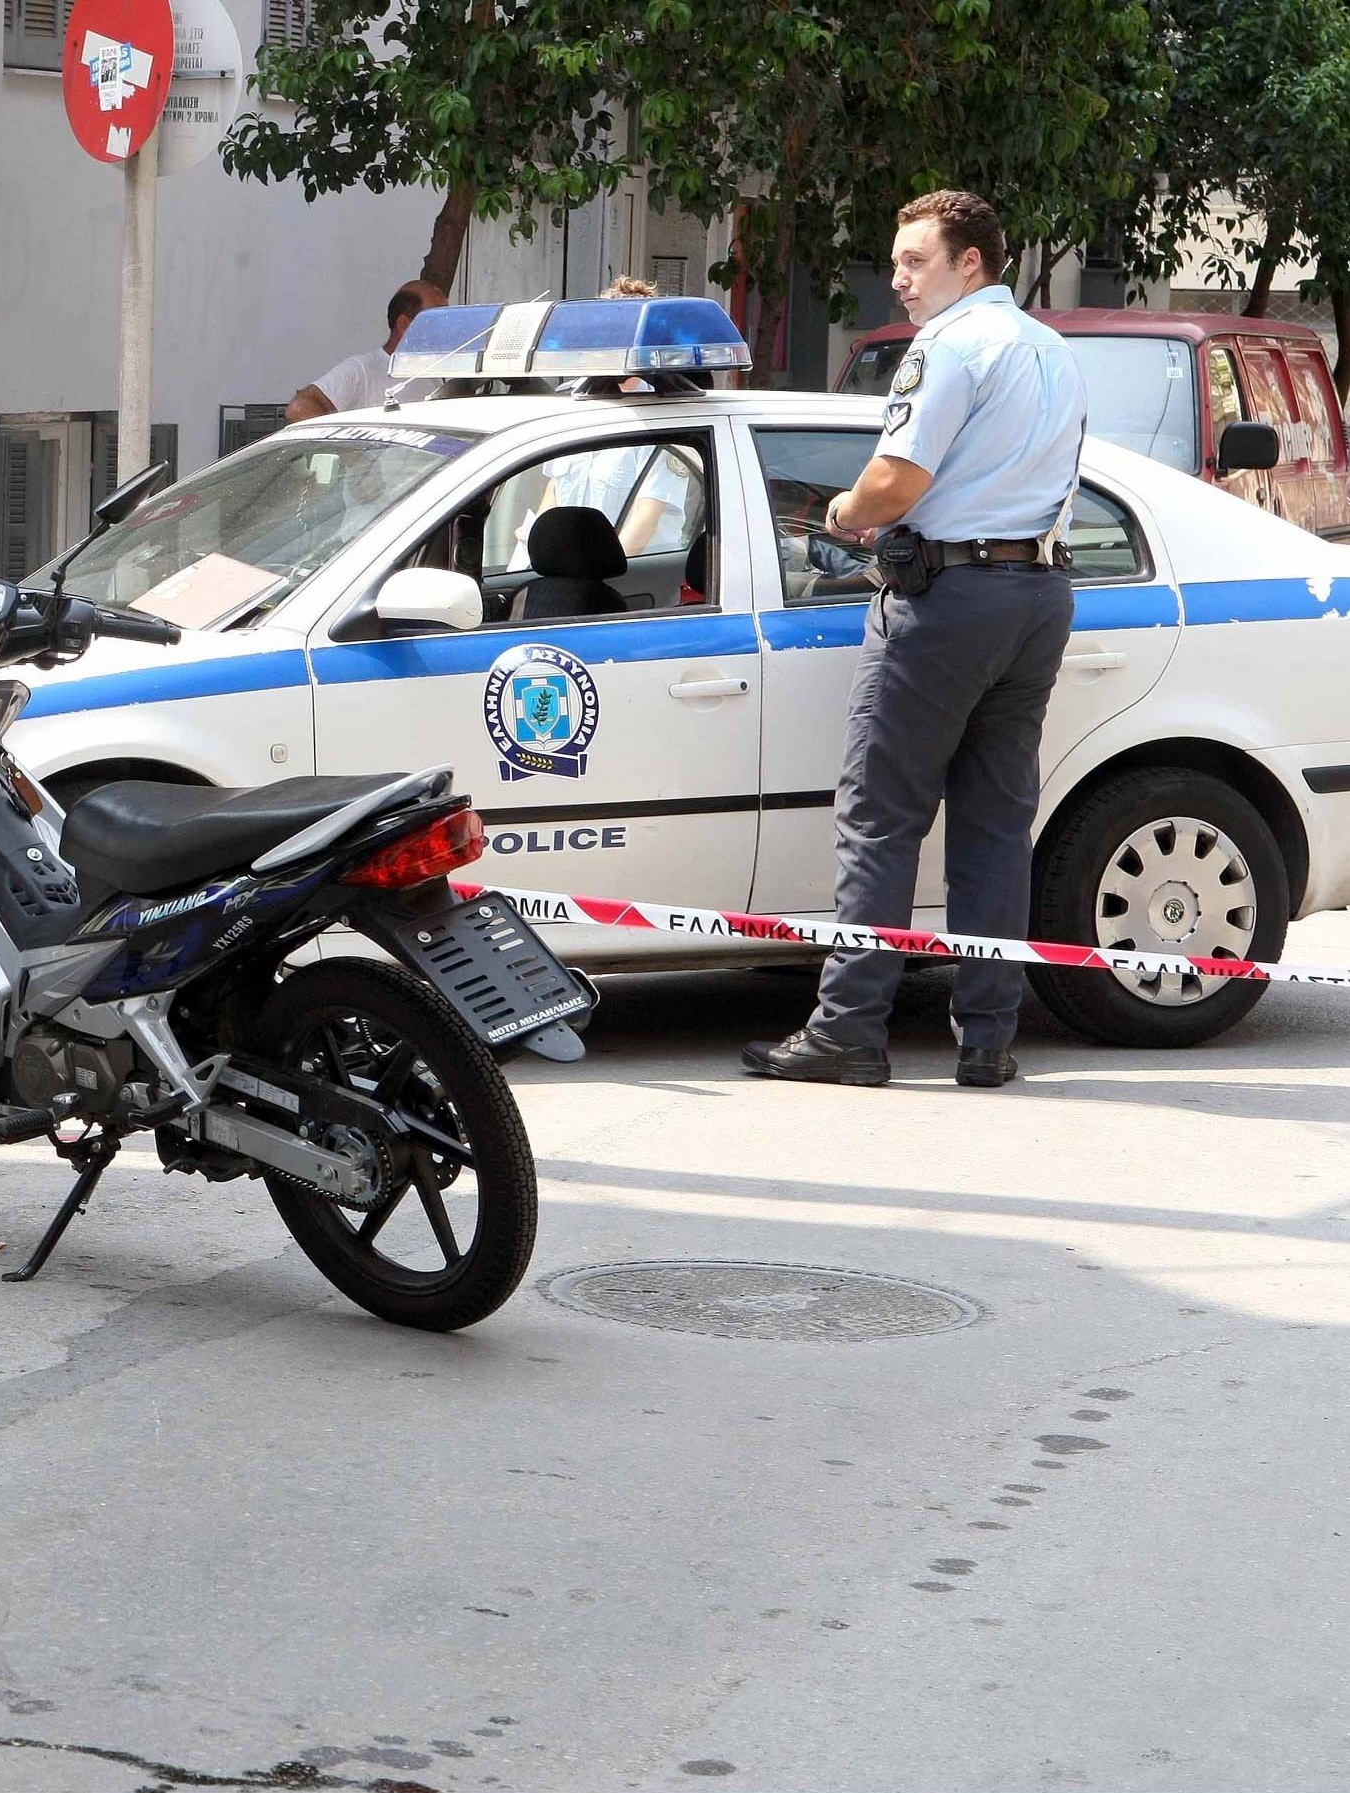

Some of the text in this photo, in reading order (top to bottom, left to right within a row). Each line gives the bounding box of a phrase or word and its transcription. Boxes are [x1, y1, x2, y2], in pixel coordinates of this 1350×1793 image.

[531, 648, 596, 746] ΑΣΤΥΝΟΜΙΑ
[137, 890, 208, 926] YINXIANG
[212, 915, 254, 951] YX125RS
